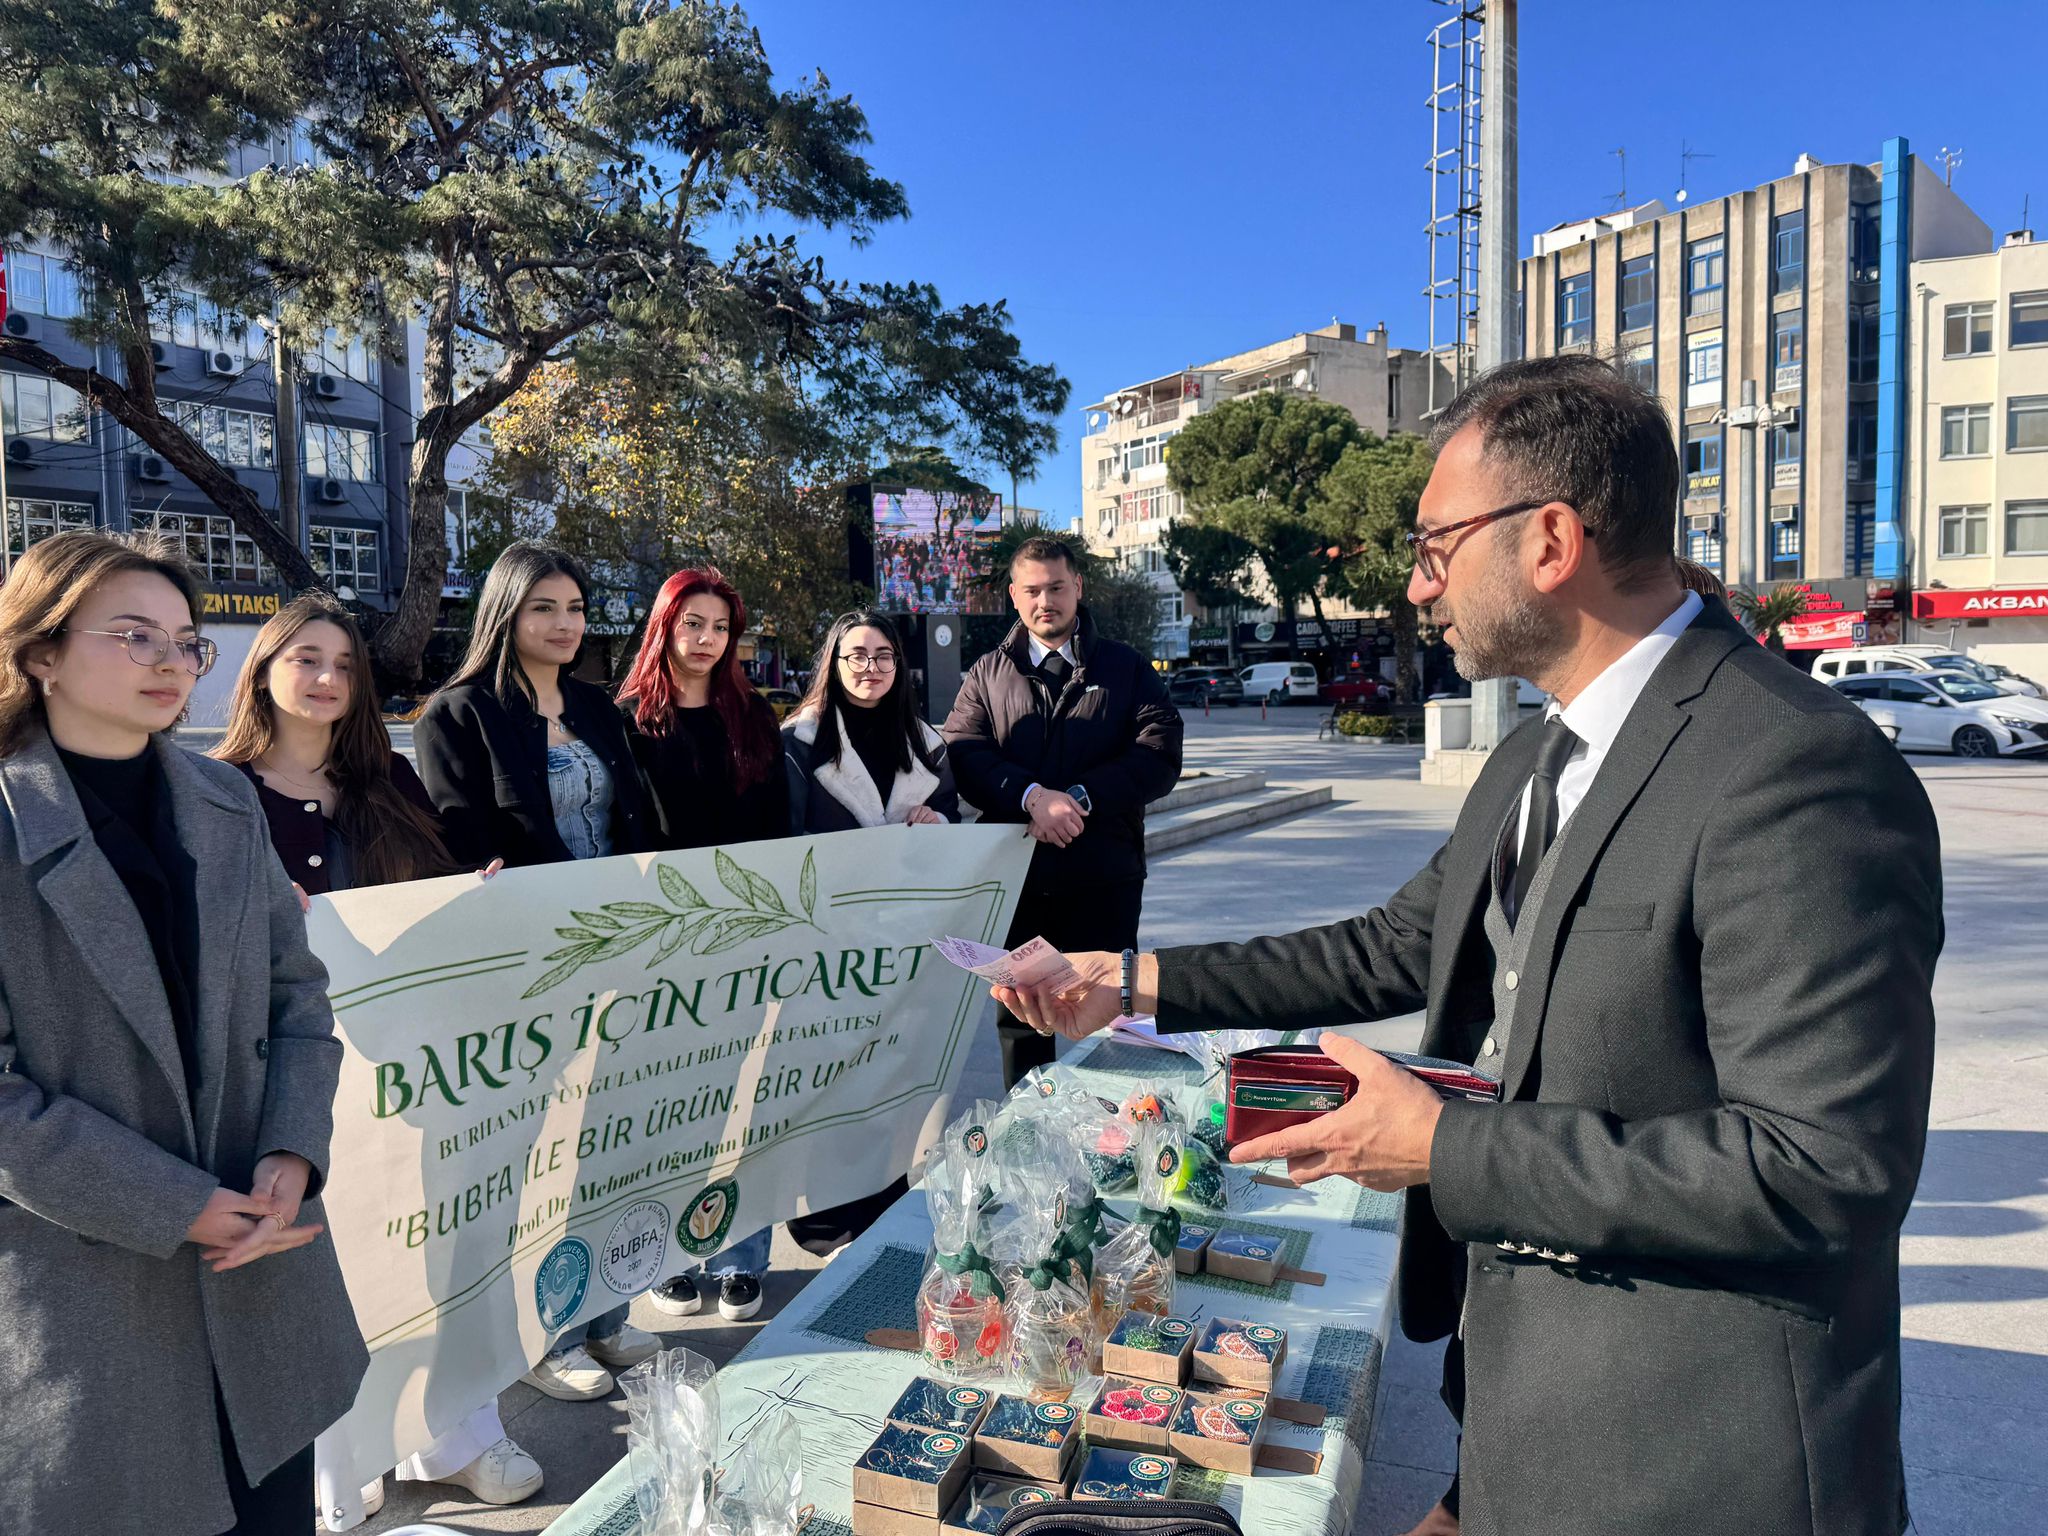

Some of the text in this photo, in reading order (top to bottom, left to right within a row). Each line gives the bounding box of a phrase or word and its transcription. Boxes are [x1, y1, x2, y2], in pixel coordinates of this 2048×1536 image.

[232, 593, 280, 614] TAKSİ
[1855, 626, 1865, 638] D
[1011, 940, 1044, 962] 200
[369, 942, 933, 1119] BARIŞ İÇİN TİCARET
[439, 1009, 883, 1161] BURHANİYE UYGULAMALI BİLİMLER FAKÜLTESİ
[523, 1138, 567, 1186] İLE
[575, 1113, 634, 1160] BİR
[645, 1084, 739, 1138] ÜRÜN,
[753, 1064, 802, 1104] BİR
[506, 1205, 545, 1247] Prof.
[548, 1193, 573, 1219] Dr.
[578, 1162, 652, 1202] Mehmet
[656, 1137, 738, 1174] Oğuzhan
[610, 1228, 658, 1265] BUBFA
[627, 1258, 642, 1273] 2007
